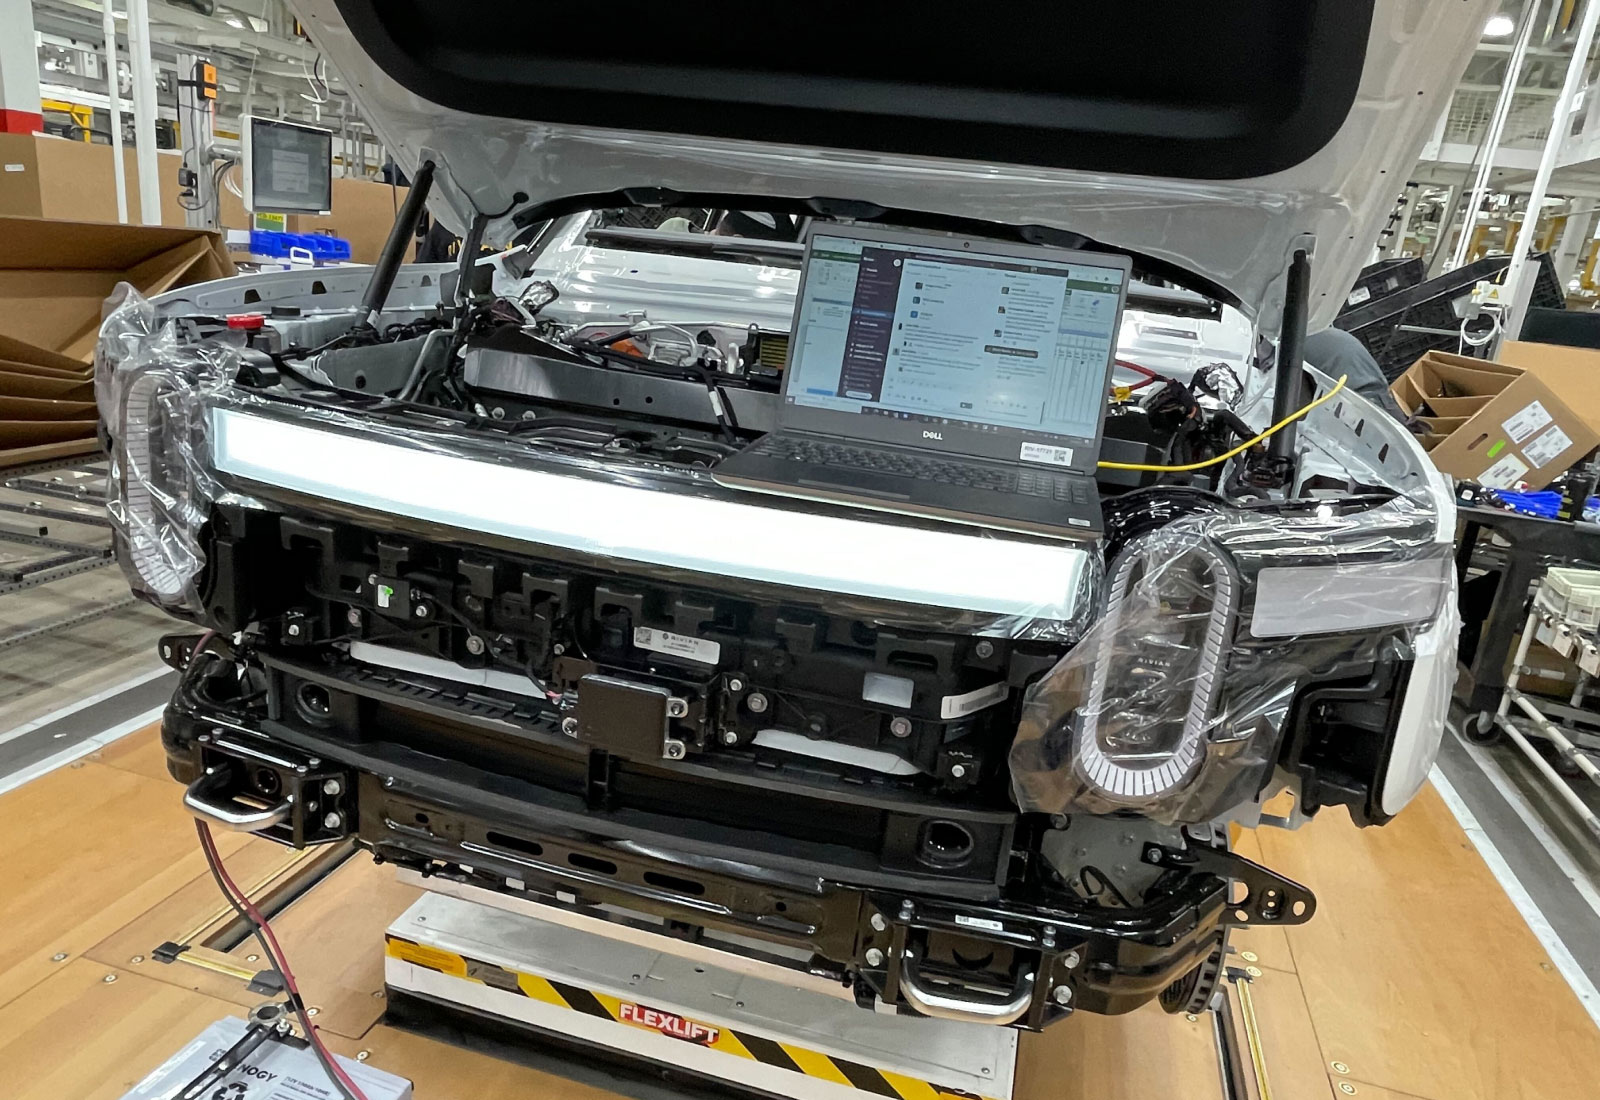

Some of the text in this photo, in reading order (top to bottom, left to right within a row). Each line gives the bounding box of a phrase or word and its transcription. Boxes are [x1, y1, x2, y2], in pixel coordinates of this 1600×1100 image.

[922, 430, 943, 441] DELL
[1137, 658, 1170, 667] RIVIAN
[620, 1003, 719, 1042] FLEXLIFT
[237, 1064, 278, 1082] NOGY
